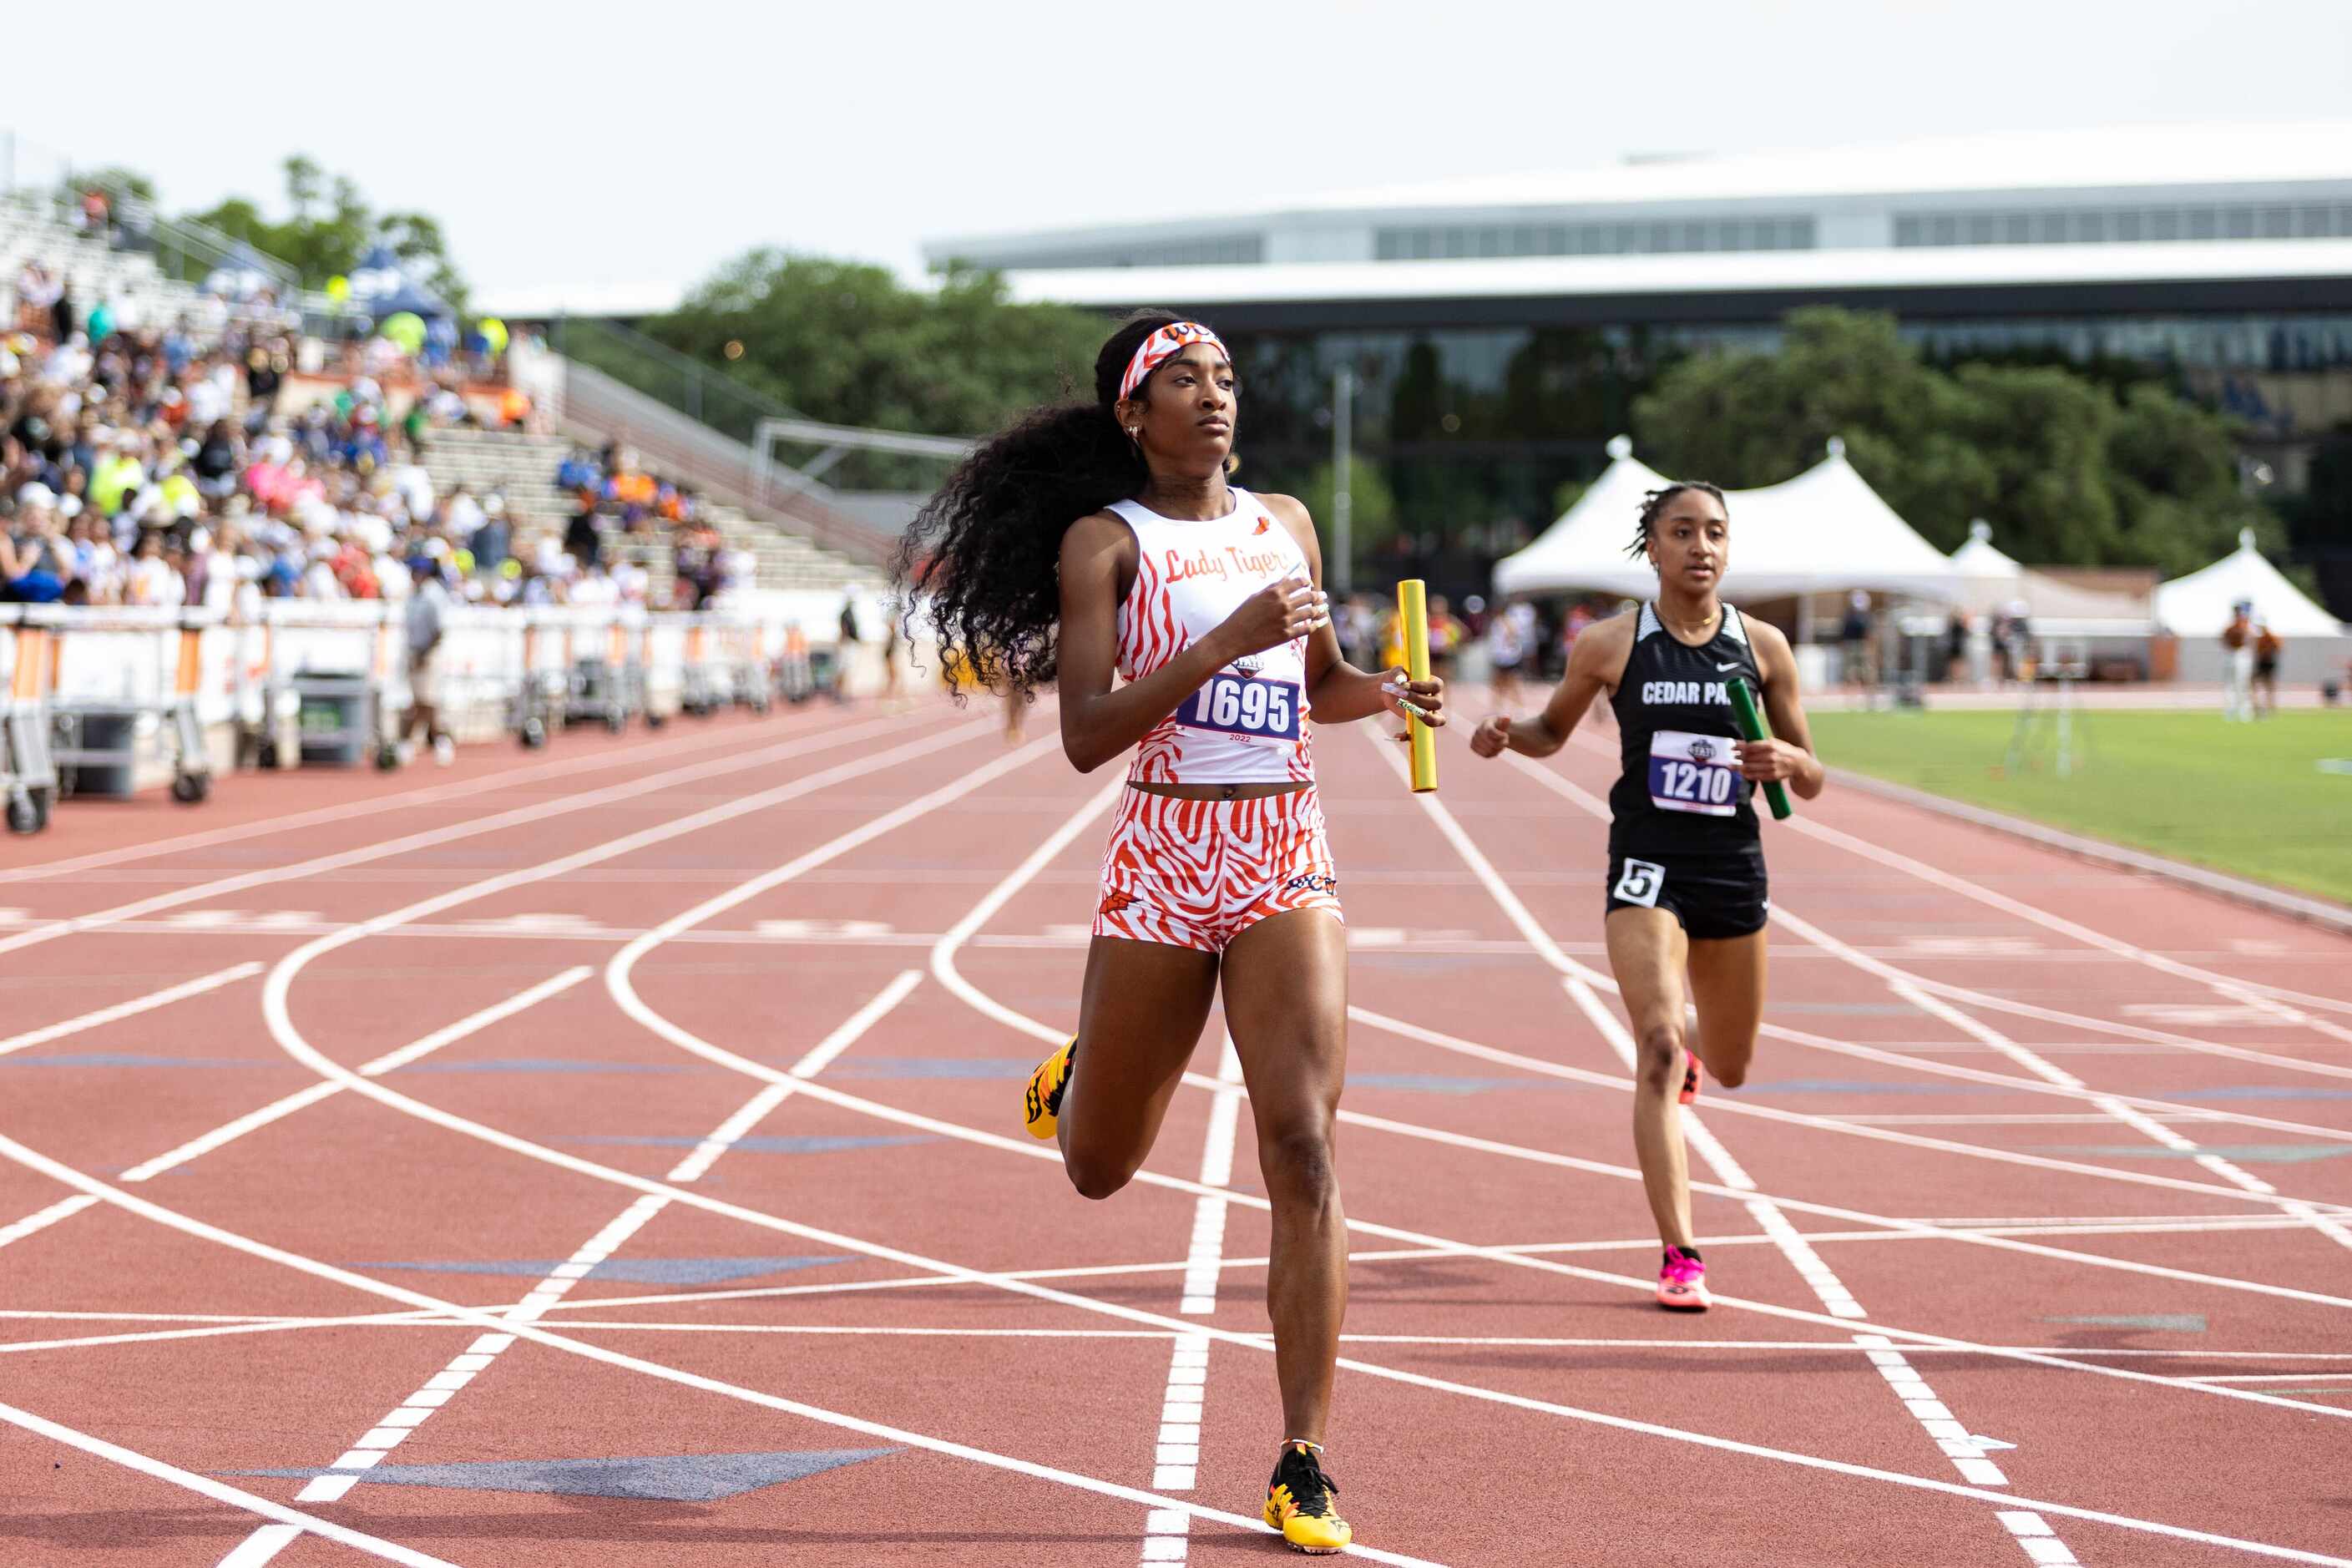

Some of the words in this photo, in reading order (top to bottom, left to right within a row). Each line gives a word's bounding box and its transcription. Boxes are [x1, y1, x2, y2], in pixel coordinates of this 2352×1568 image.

[1166, 549, 1227, 584] Lady
[1196, 679, 1289, 732] 1695
[1642, 681, 1700, 705] CEDAR
[1704, 681, 1732, 706] PA
[1229, 734, 1251, 742] 2022
[1662, 761, 1732, 803] 1210
[1623, 864, 1655, 898] 5
